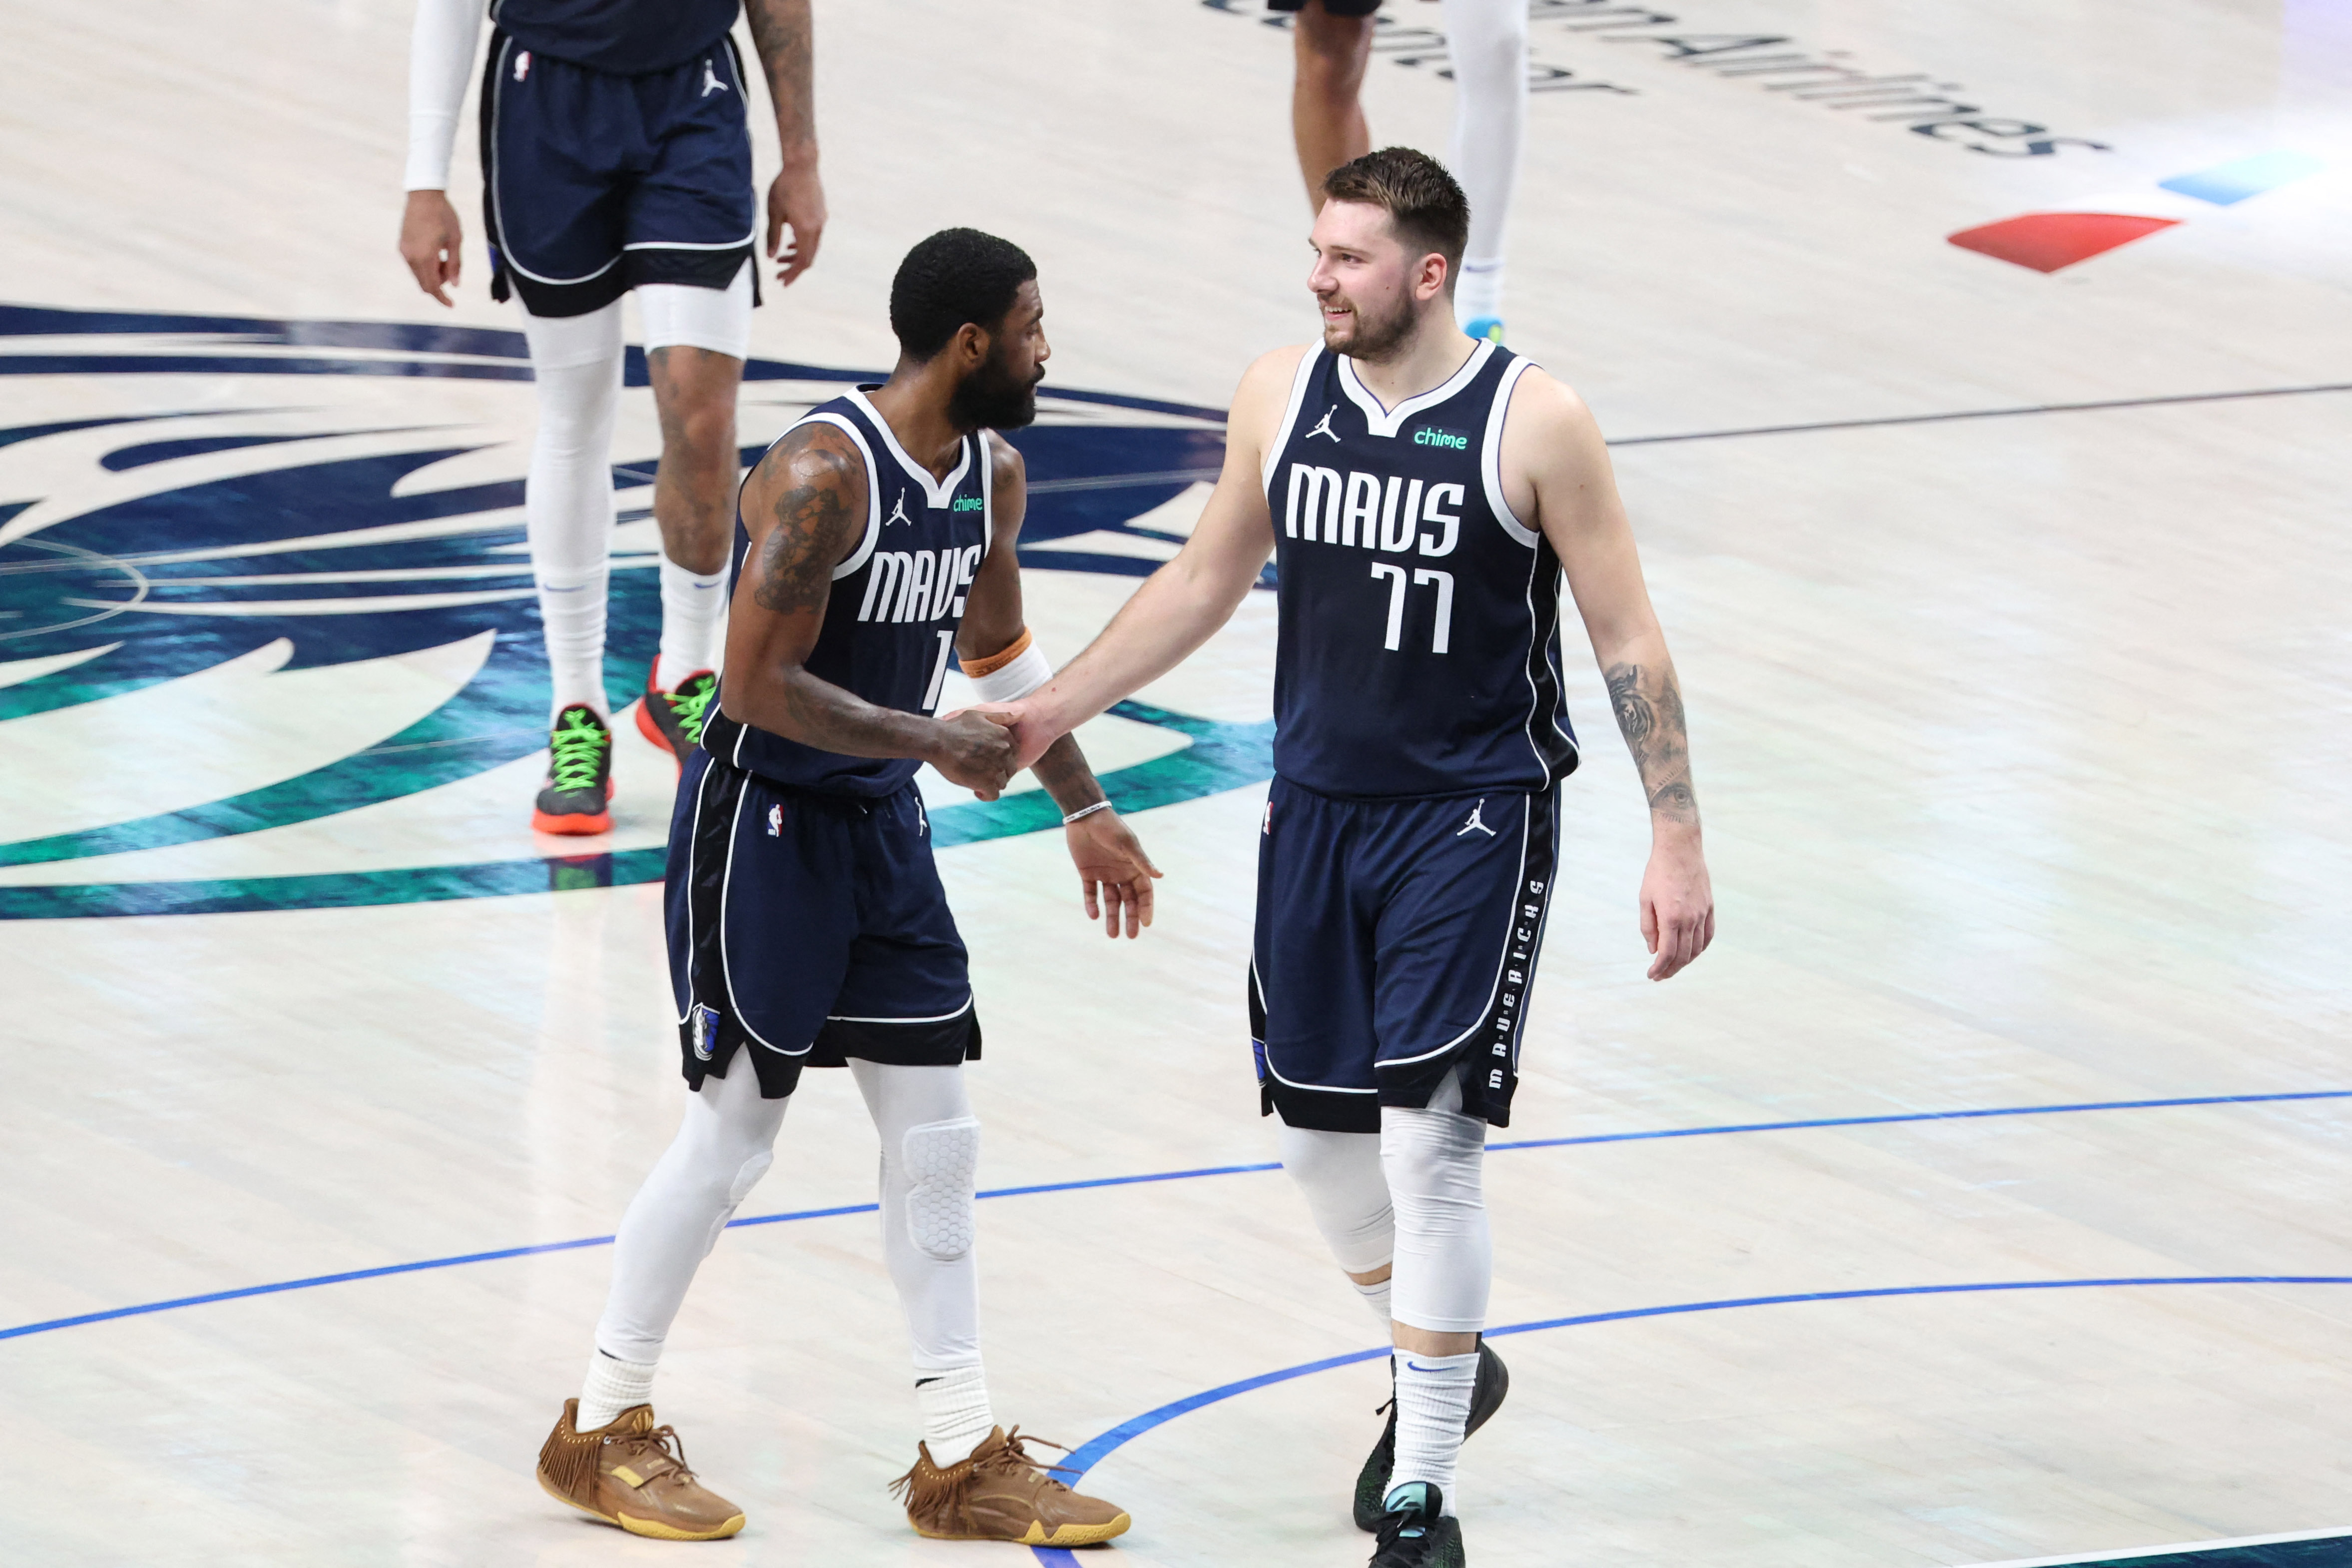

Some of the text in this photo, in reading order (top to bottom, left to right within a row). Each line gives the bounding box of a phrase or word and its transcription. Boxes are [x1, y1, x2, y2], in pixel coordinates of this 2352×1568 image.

[1597, 33, 2115, 158] Airlines
[1413, 427, 1467, 450] chime
[953, 494, 983, 513] chime
[1286, 463, 1465, 557] MAVS
[857, 544, 982, 623] MAVS
[1371, 561, 1454, 654] 77
